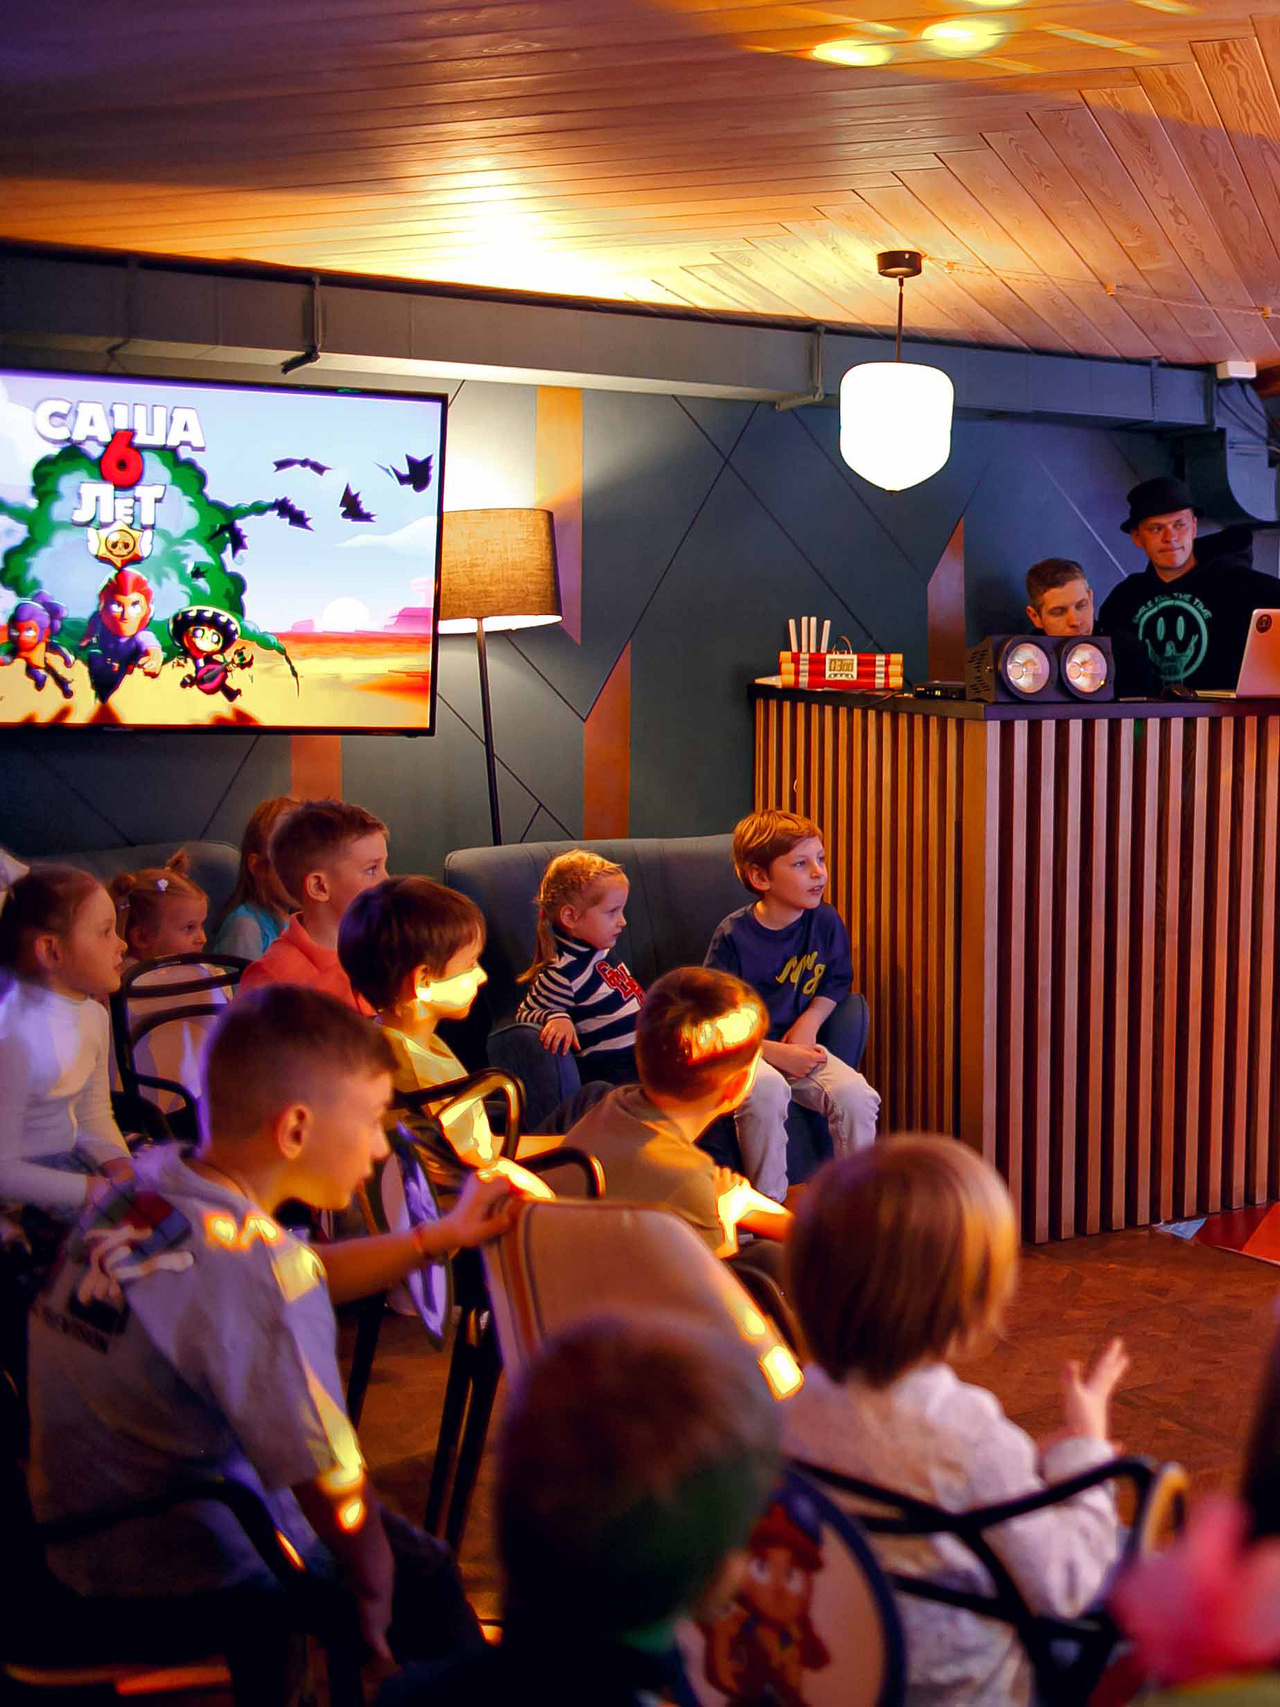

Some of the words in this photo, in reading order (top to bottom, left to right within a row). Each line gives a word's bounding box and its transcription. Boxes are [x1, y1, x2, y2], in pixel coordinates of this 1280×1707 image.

[36, 399, 206, 452] САША
[100, 429, 144, 487] 6
[71, 481, 166, 527] ЛЕТ
